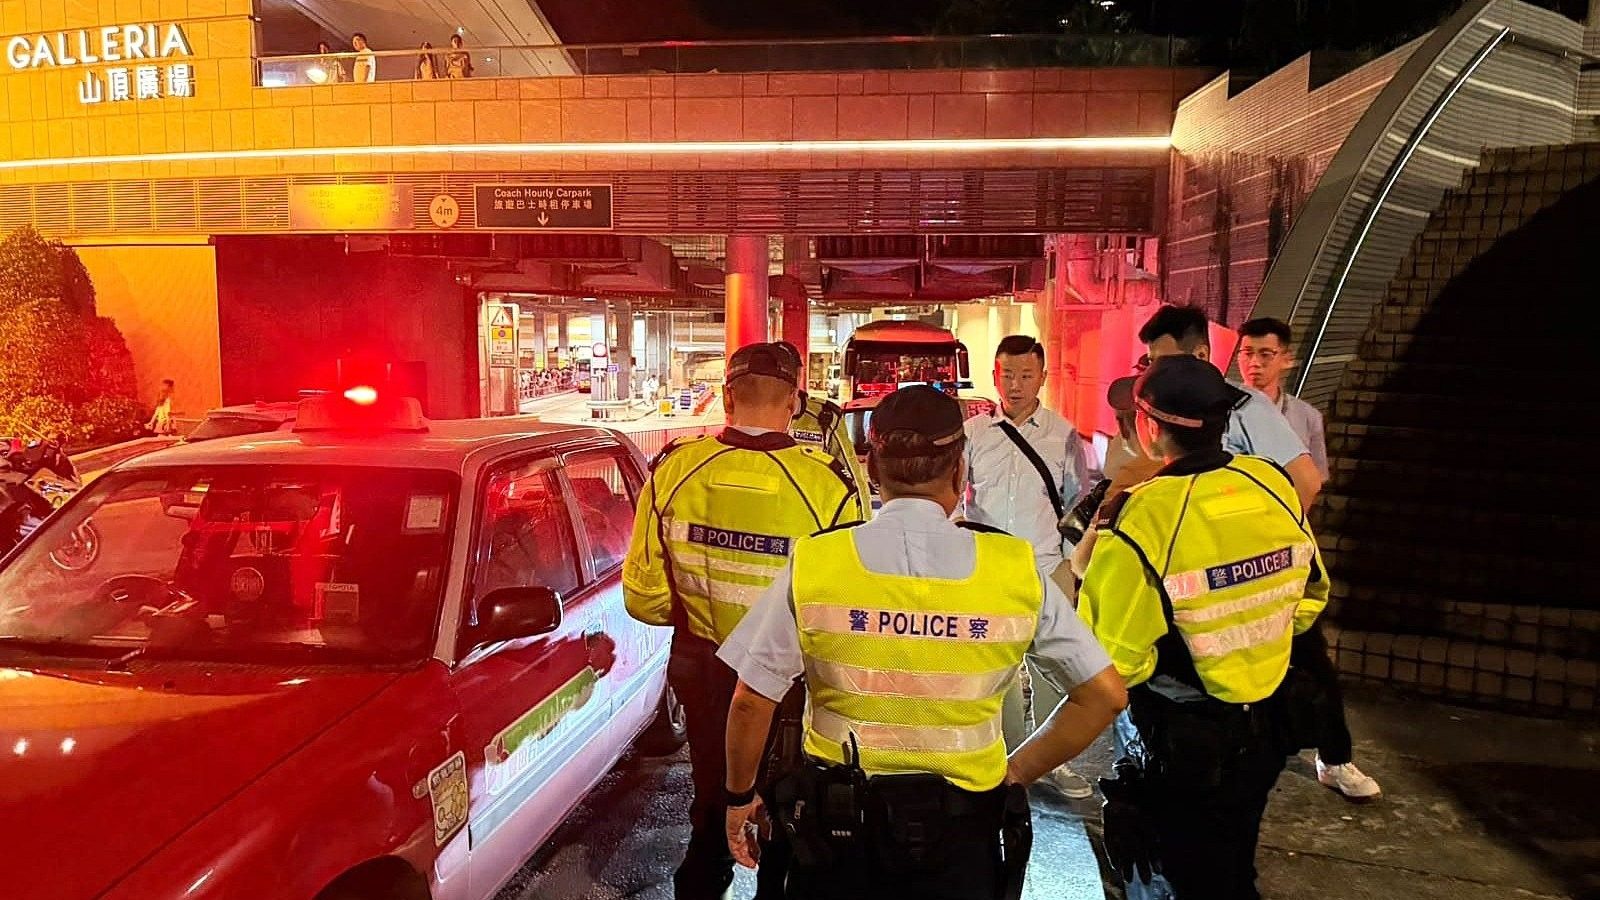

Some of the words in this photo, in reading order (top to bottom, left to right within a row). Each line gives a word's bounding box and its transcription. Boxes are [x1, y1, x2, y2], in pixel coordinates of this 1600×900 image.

[7, 23, 190, 69] GALLERIA
[79, 63, 193, 104] 山頂廣場
[494, 188, 521, 198] Coach
[524, 188, 554, 199] Hourly
[556, 188, 592, 199] Carpark
[436, 205, 453, 216] 4m
[707, 530, 765, 552] POLICE
[1231, 553, 1281, 583] POLICE
[849, 610, 868, 632] 警
[879, 611, 958, 638] POLICE
[969, 617, 989, 639] 察
